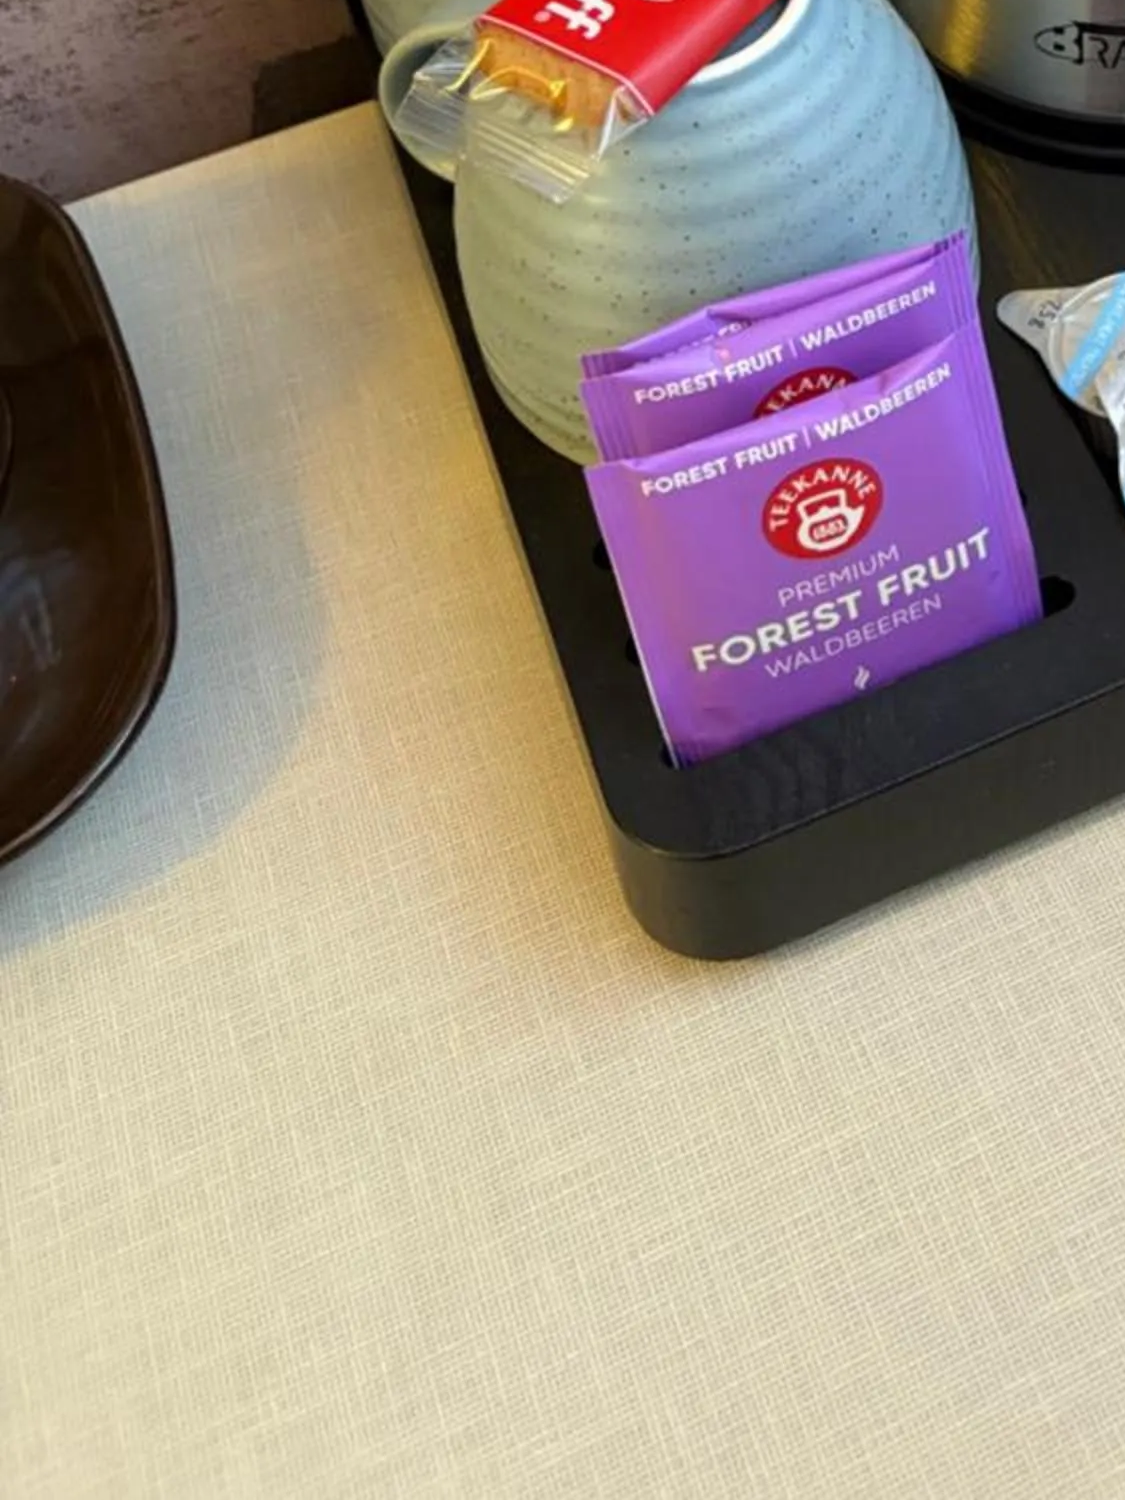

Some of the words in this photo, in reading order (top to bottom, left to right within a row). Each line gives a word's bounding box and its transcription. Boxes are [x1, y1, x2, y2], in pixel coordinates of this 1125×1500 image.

[634, 368, 719, 404] FOREST
[723, 346, 785, 382] FRUIT
[800, 281, 937, 353] WALDBEEREN
[642, 457, 729, 498] FOREST
[735, 432, 799, 468] FRUIT
[815, 363, 951, 442] WALDBEEREN
[768, 464, 877, 532] TEEKANNE
[691, 591, 863, 672] FOREST
[878, 527, 991, 605] FRUIT
[778, 544, 900, 607] PREMIUM
[764, 595, 943, 678] WALDBEEREN
